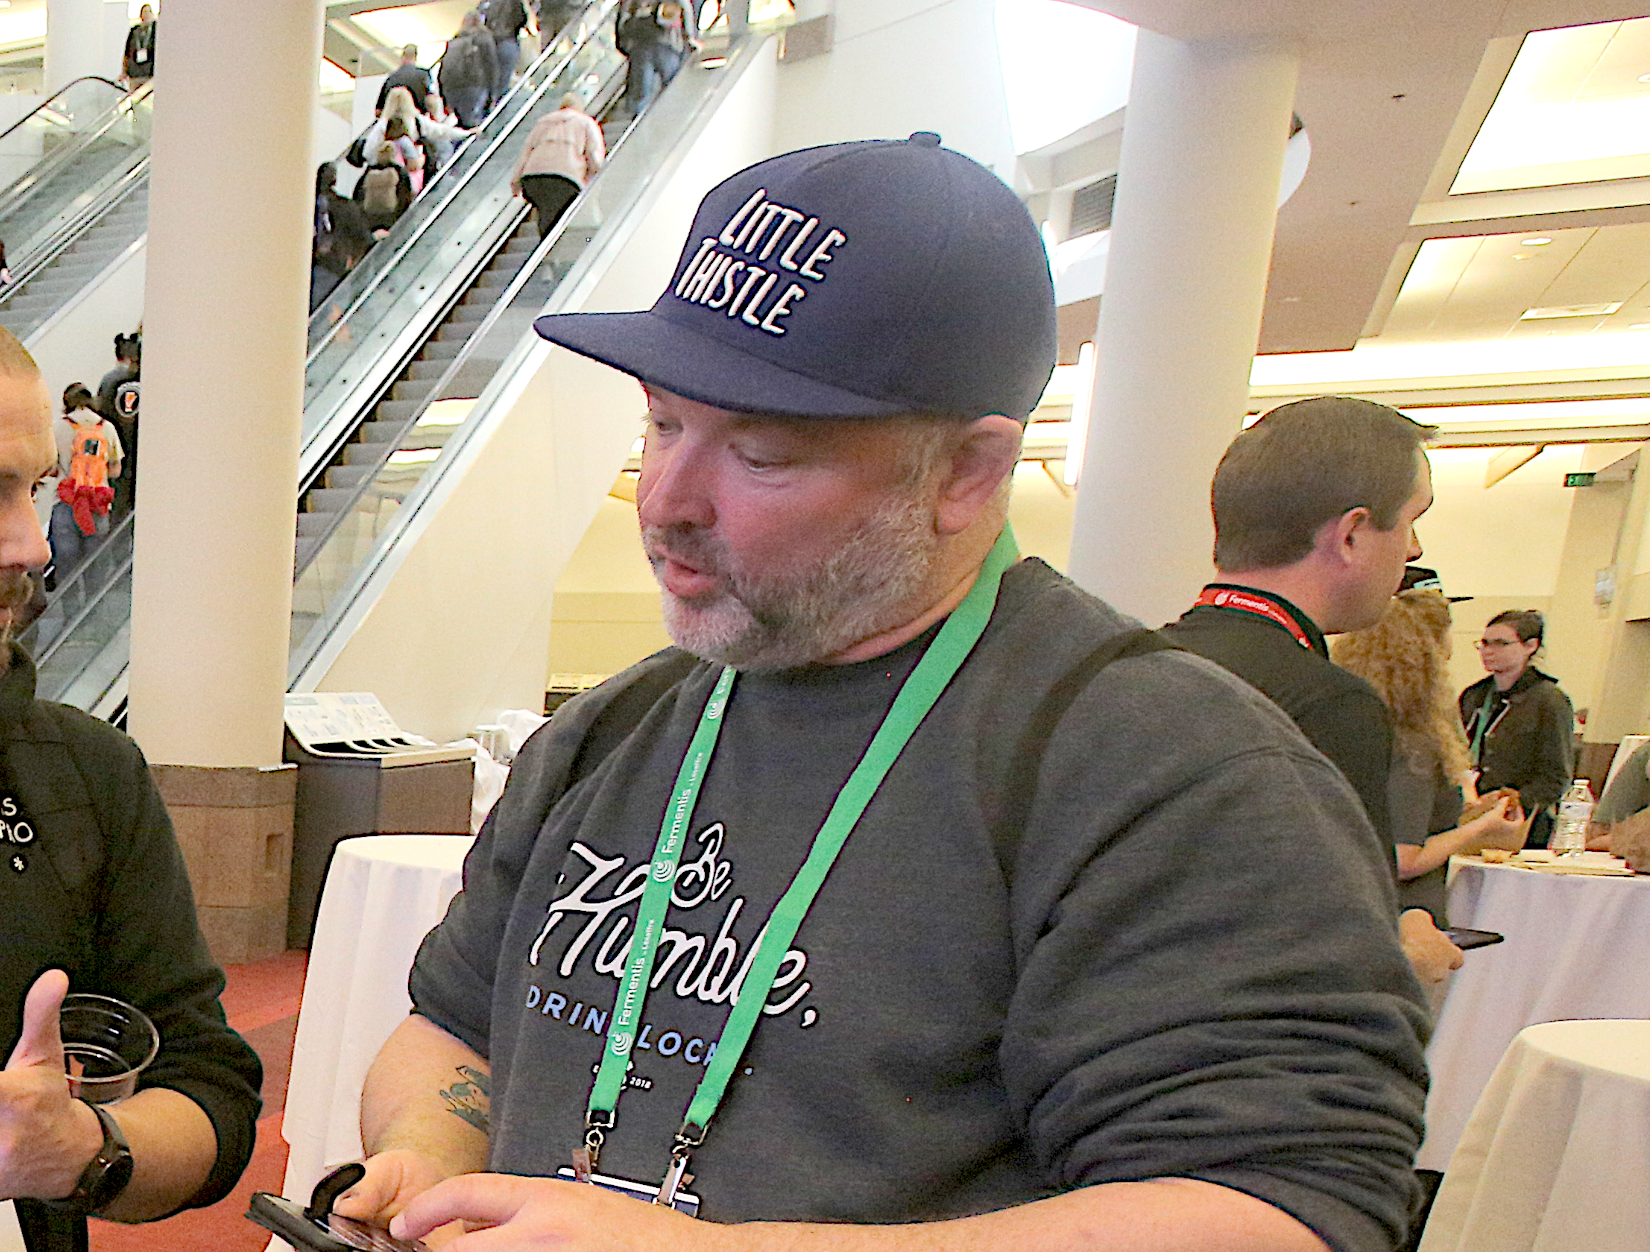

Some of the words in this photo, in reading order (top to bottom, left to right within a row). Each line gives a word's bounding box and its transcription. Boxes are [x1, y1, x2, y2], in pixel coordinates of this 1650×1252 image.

[718, 187, 847, 281] LITTLE
[674, 237, 806, 335] THISTLE
[662, 789, 692, 854] Fermentis
[525, 984, 608, 1035] DRIN
[618, 957, 645, 1026] Fermentis
